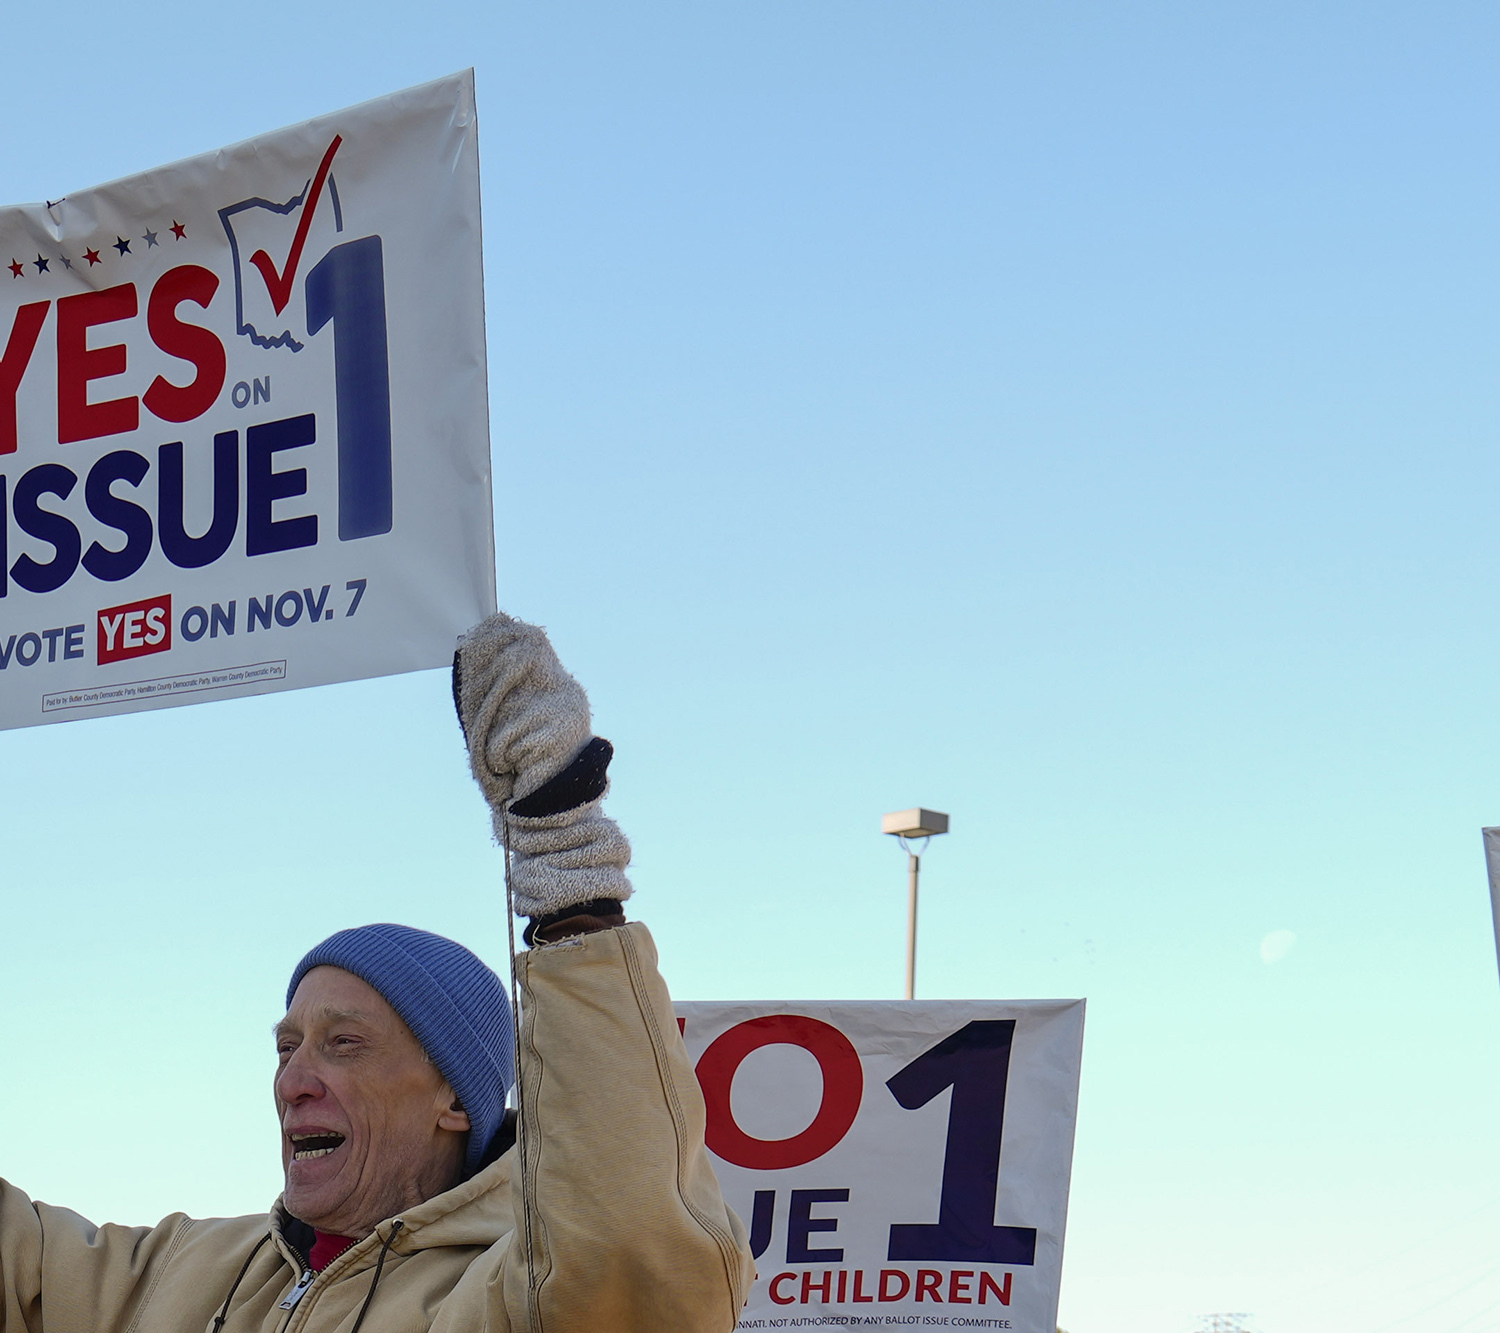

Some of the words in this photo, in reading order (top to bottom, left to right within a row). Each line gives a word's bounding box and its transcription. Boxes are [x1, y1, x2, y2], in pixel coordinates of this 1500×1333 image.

[231, 375, 271, 410] ON
[305, 234, 393, 542] 1
[99, 604, 168, 652] YES
[179, 600, 237, 643] ON
[245, 587, 335, 636] NOV.
[344, 578, 368, 619] 7
[83, 692, 99, 703] County
[99, 689, 124, 700] Democratic
[137, 683, 156, 695] Hamilton
[157, 681, 172, 693] County
[173, 678, 198, 690] Democratic
[228, 671, 244, 683] County
[244, 667, 269, 679] Democratic
[677, 1014, 864, 1171] O
[886, 1019, 1038, 1267] 1
[768, 1269, 1013, 1307] CHILDREN
[737, 1319, 767, 1329] NNATI.
[769, 1318, 789, 1328] NOT
[790, 1316, 849, 1327] AUTHORIZED
[850, 1316, 863, 1325] BY
[863, 1315, 884, 1326] ANY
[885, 1315, 921, 1326] BALLOT
[922, 1315, 949, 1327] ISSUE
[951, 1317, 1013, 1330] COMMITTEE.
